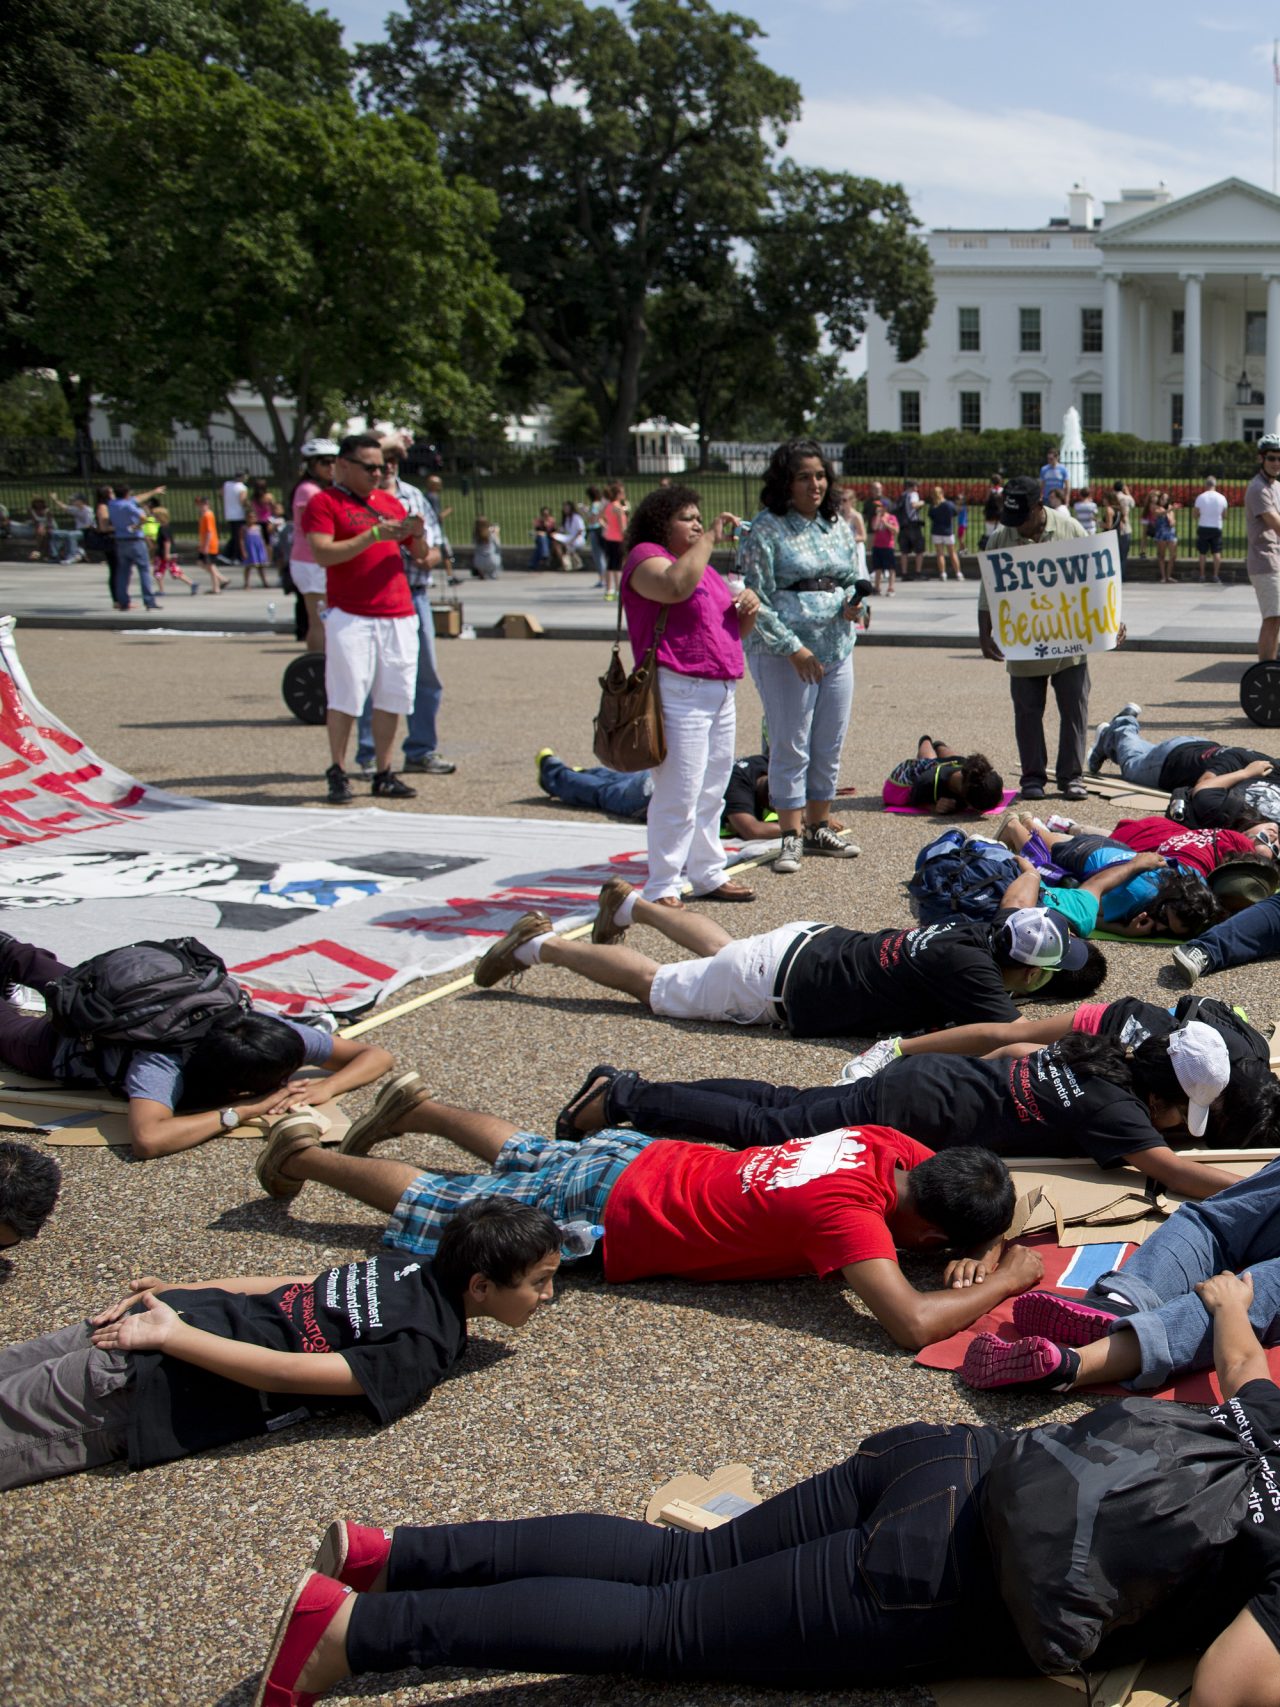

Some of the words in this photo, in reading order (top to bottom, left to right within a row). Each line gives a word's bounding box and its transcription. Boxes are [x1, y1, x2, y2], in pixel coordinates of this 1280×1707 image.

[987, 548, 1116, 593] Brown
[1030, 592, 1055, 610] is
[1050, 643, 1085, 656] GLAHR
[1053, 1077, 1072, 1108] entire
[367, 1288, 384, 1328] numbers!
[1247, 1486, 1265, 1524] tire
